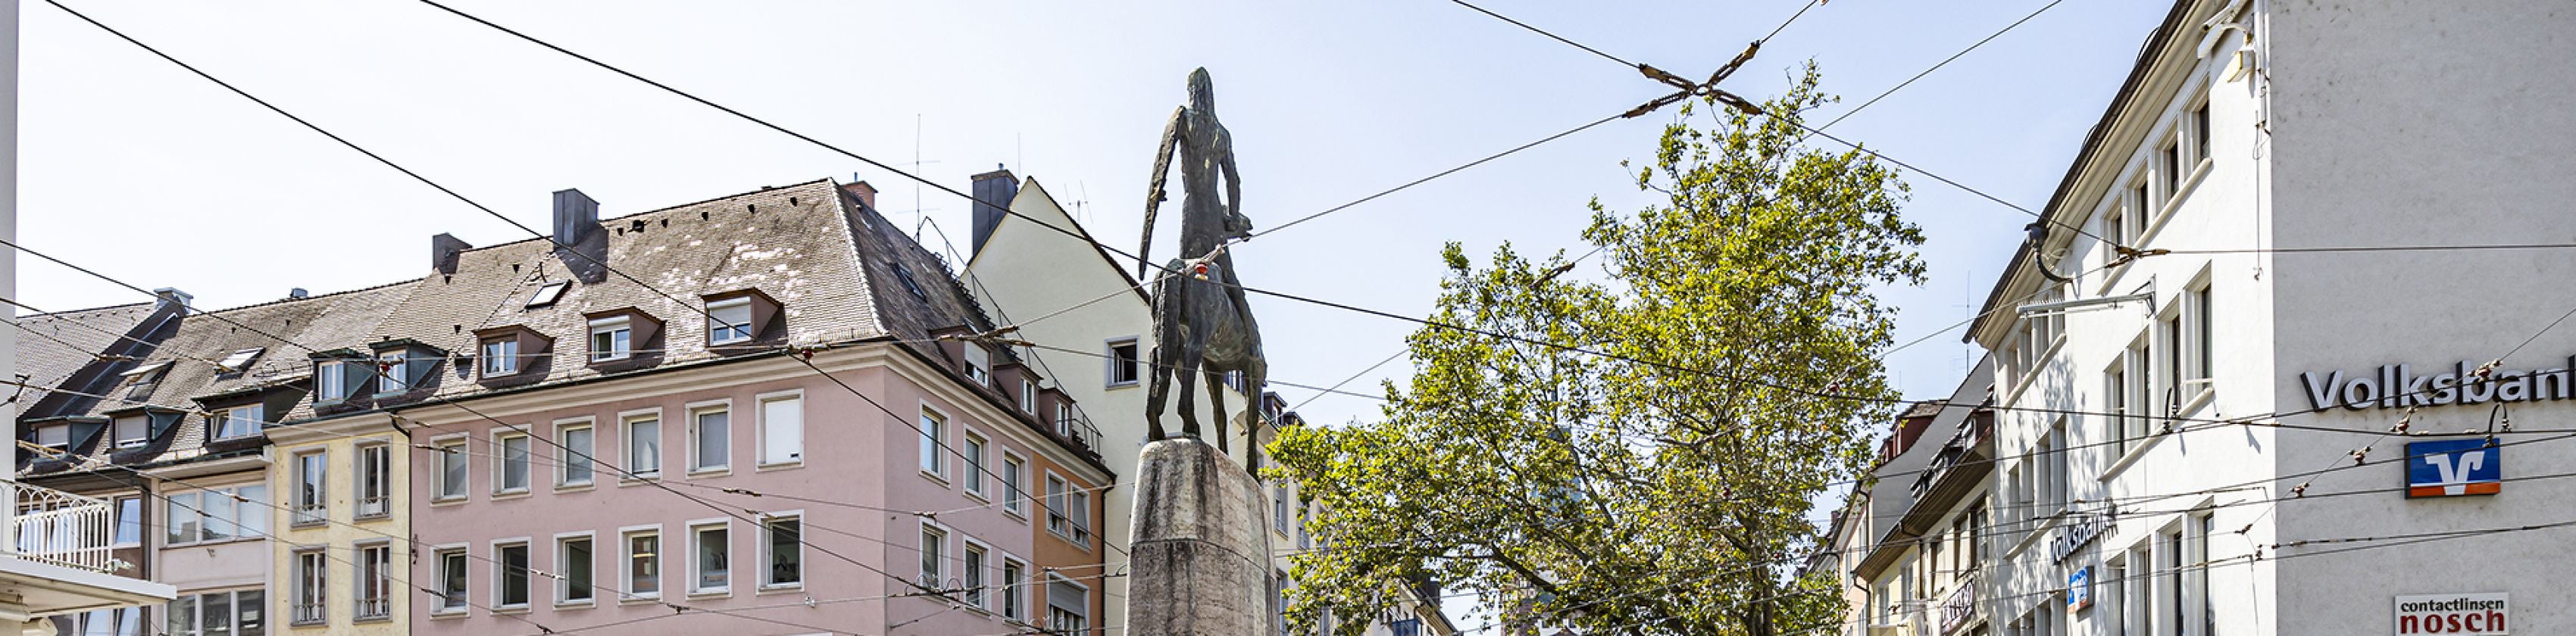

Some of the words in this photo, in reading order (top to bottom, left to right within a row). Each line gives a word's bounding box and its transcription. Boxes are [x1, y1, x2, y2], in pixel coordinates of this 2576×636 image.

[2300, 354, 2576, 411] Volksban
[2401, 598, 2504, 612] contactlinsen
[2399, 610, 2505, 634] nosch
